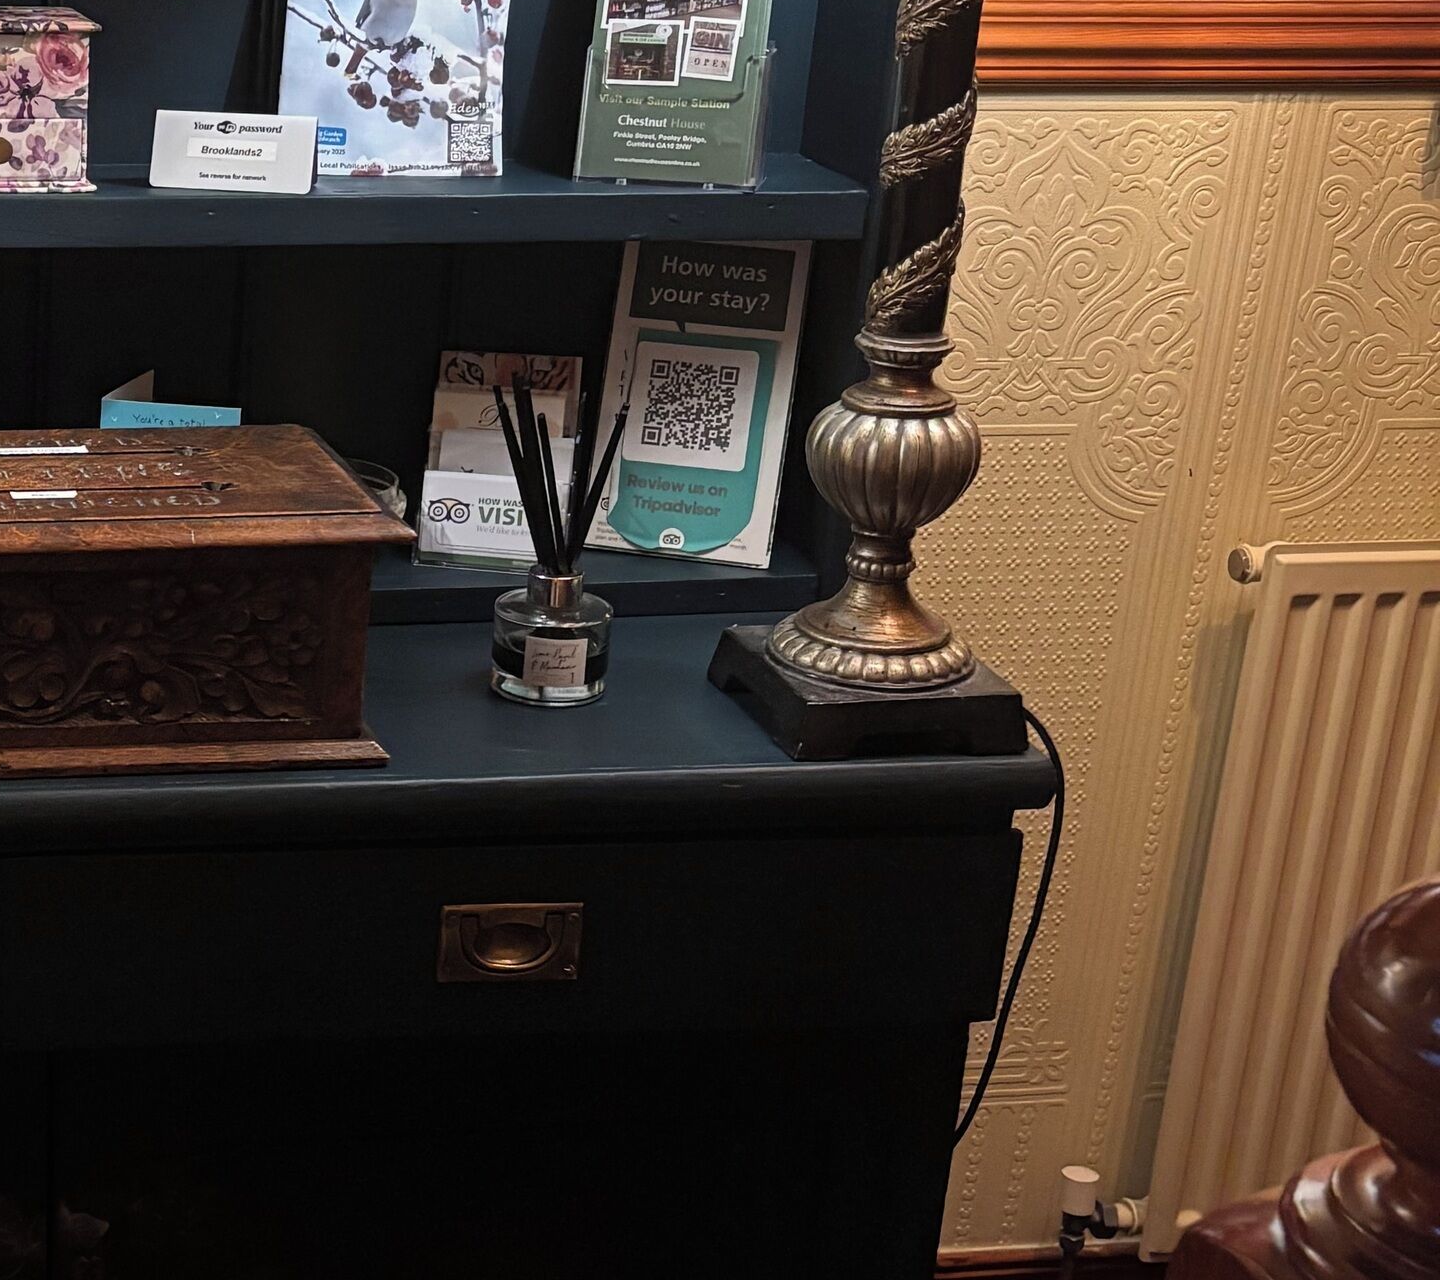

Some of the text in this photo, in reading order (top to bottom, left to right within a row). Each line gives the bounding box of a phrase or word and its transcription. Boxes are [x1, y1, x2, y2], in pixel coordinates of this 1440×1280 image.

[599, 93, 731, 110] Visit our Sample Station
[194, 122, 283, 134] Your password
[617, 114, 707, 130] Chestnut House
[200, 145, 264, 158] Brooklands2
[660, 254, 768, 284] How was
[650, 285, 771, 313] your stay?
[133, 413, 164, 426] You're
[627, 473, 686, 494] Review
[688, 481, 705, 496] us
[478, 497, 524, 508] HOW WAS
[633, 494, 722, 518] Tripadvisor
[479, 506, 524, 527] VISI
[476, 525, 495, 534] We'd
